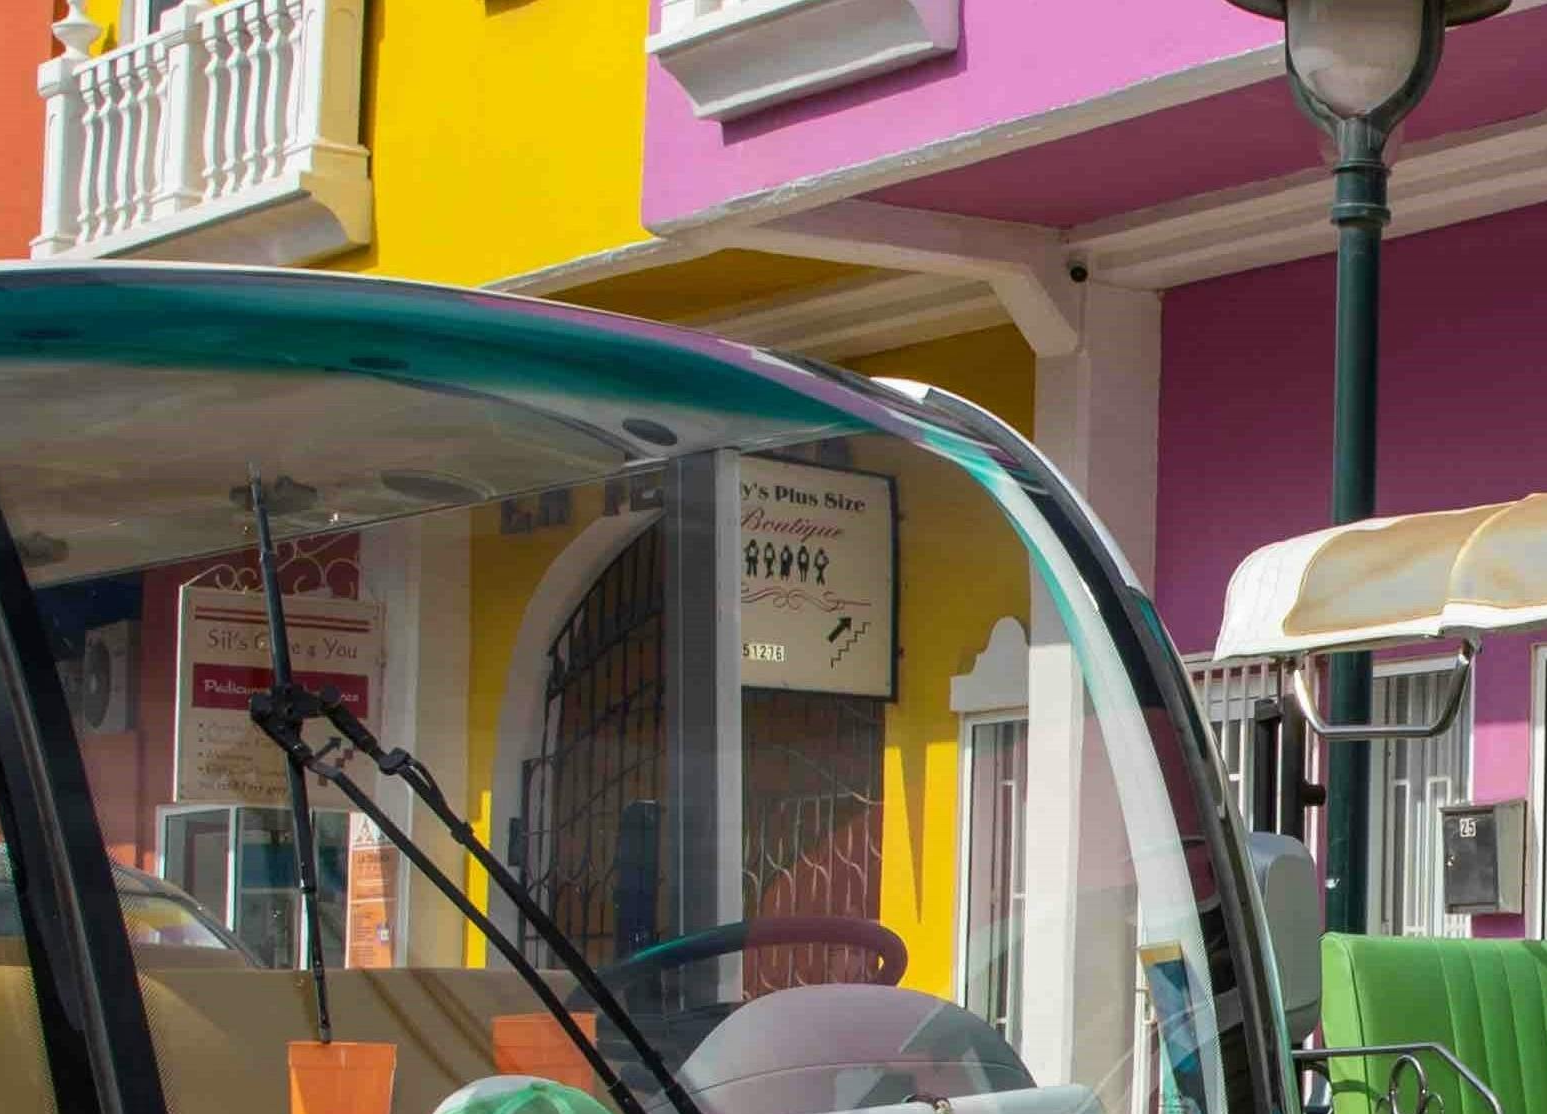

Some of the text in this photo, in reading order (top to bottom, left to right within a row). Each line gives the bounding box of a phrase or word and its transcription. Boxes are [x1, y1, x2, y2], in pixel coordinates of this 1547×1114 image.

[775, 485, 818, 506] Plus
[824, 492, 866, 513] Size
[741, 507, 843, 542] Boutique
[208, 628, 249, 650] Sil's
[323, 636, 358, 660] You
